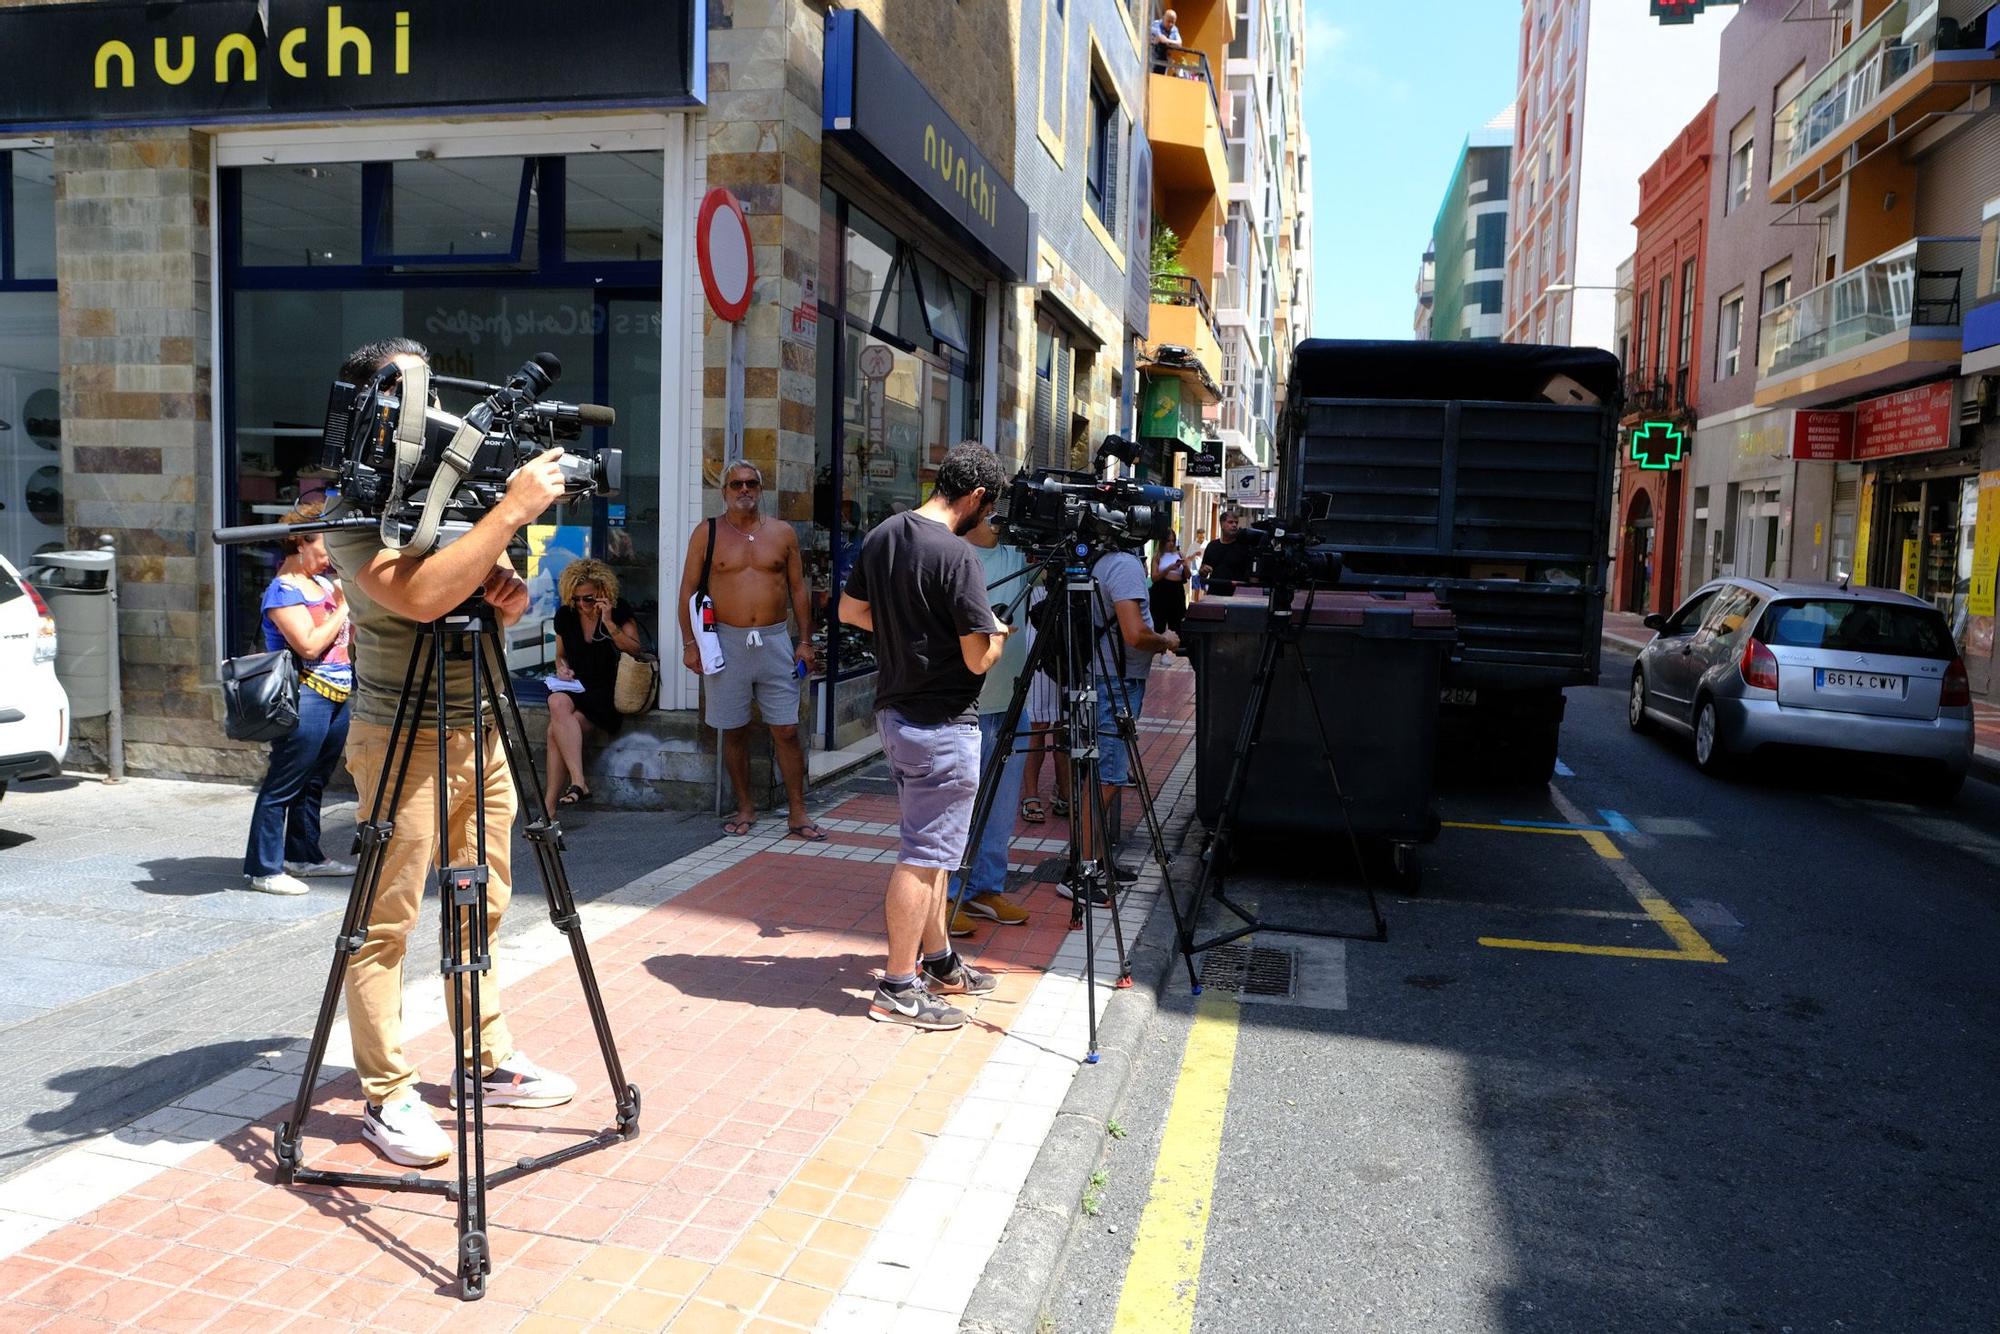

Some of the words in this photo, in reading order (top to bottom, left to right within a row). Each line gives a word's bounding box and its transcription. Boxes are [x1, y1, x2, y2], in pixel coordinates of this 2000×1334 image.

[94, 6, 410, 88] nunchi
[924, 124, 996, 228] nunchi
[484, 439, 506, 448] SONY
[1164, 487, 1181, 499] tve
[1908, 542, 1918, 591] TABAC
[1828, 672, 1864, 688] 6614
[1869, 675, 1897, 691] CWV
